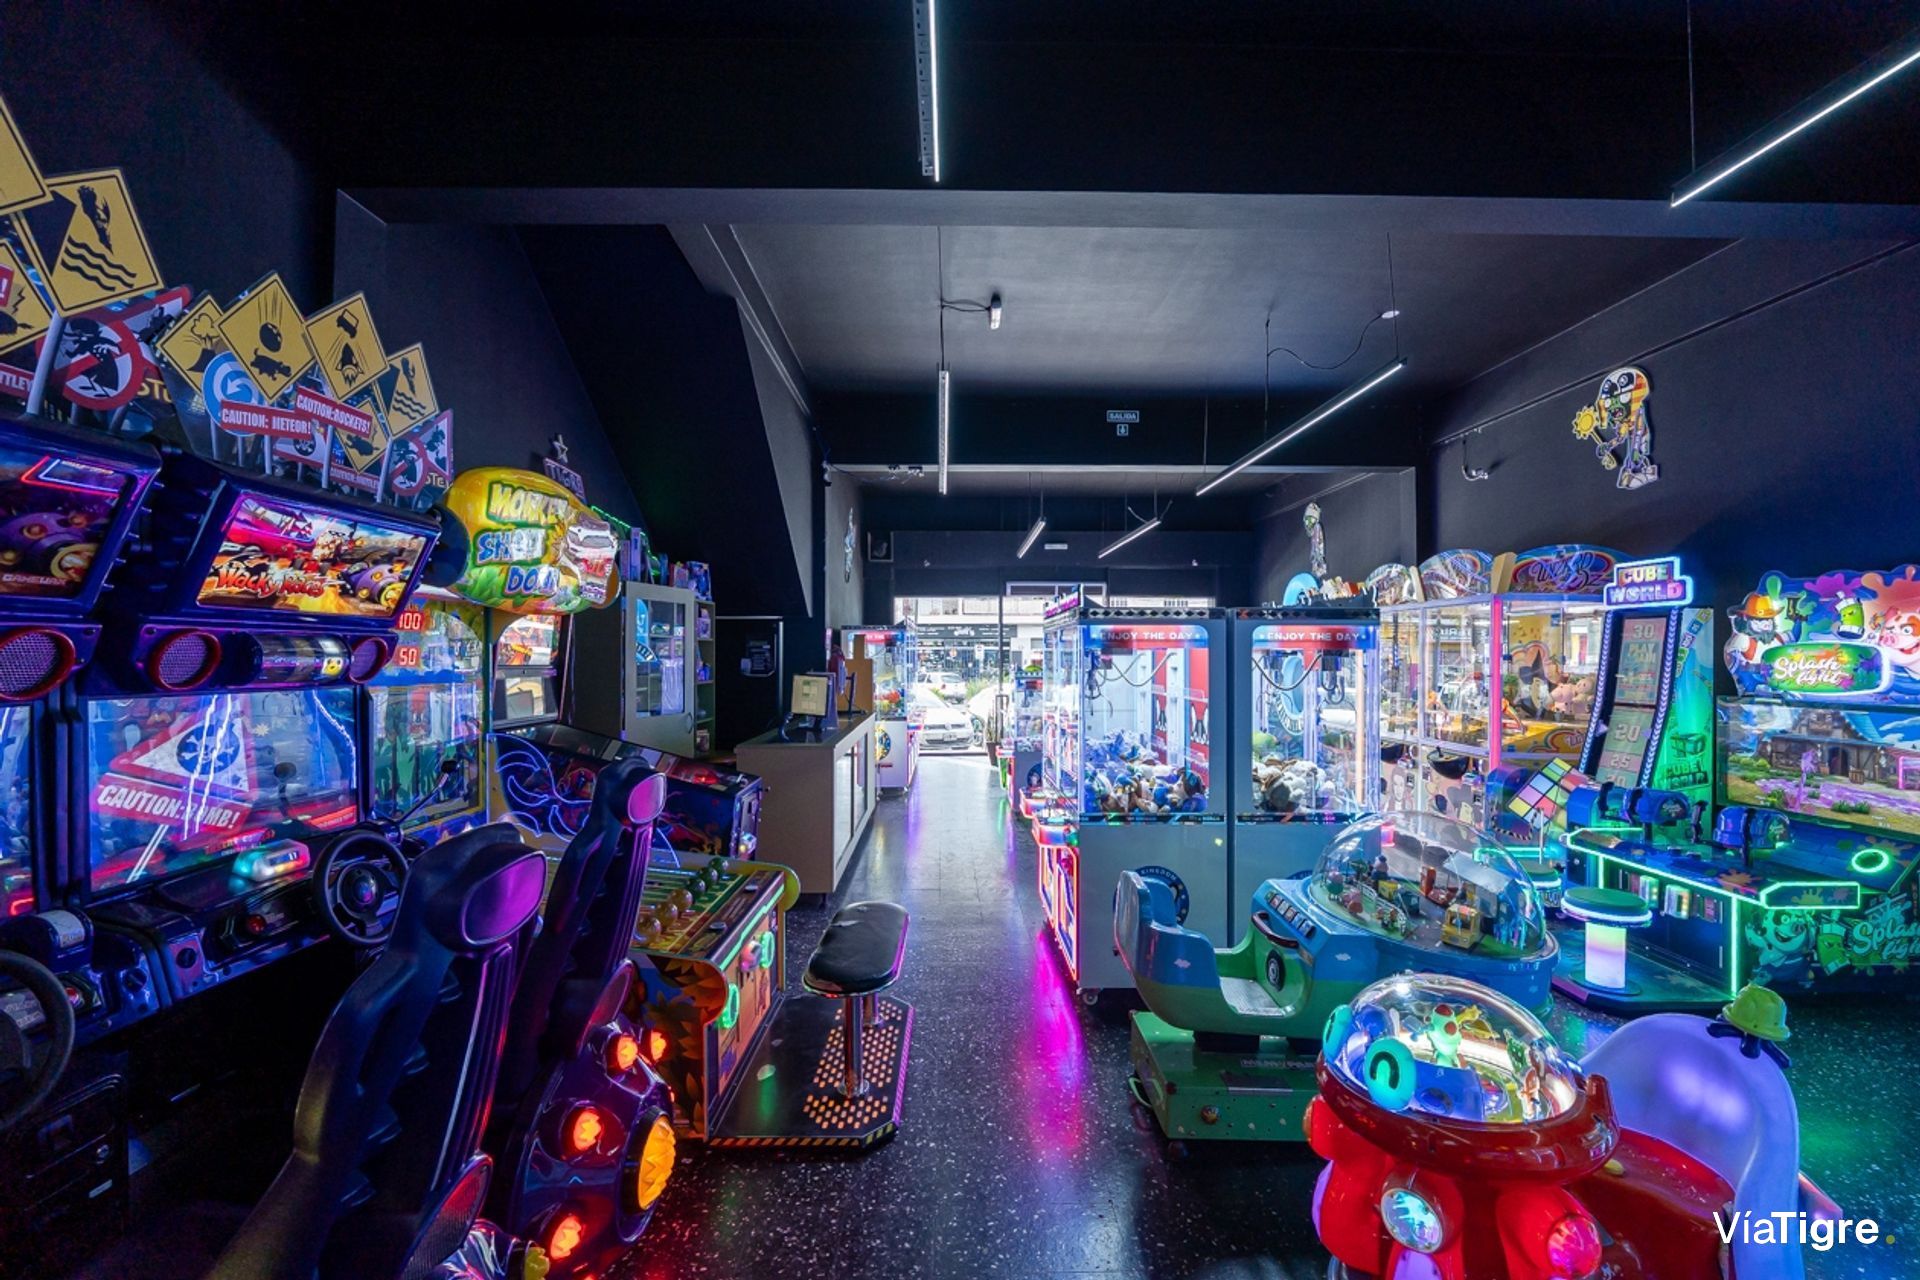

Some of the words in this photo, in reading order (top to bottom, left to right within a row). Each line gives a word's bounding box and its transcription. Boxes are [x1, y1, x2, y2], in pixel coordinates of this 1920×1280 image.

[222, 408, 268, 428] CAUTION:
[272, 417, 311, 434] METEOR!
[1110, 412, 1137, 420] SALIDA
[1620, 563, 1669, 585] CUBE
[1609, 582, 1683, 602] WORLD
[1100, 632, 1138, 640] ENJOY
[1143, 632, 1167, 640] THE
[1267, 632, 1305, 641] ENJOY
[1310, 632, 1332, 641] THE
[1336, 632, 1360, 641] DAY
[399, 648, 418, 666] 50
[1774, 655, 1841, 679] Splash
[1615, 723, 1641, 742] 20
[1610, 753, 1631, 768] 25
[1852, 918, 1920, 954] Splas
